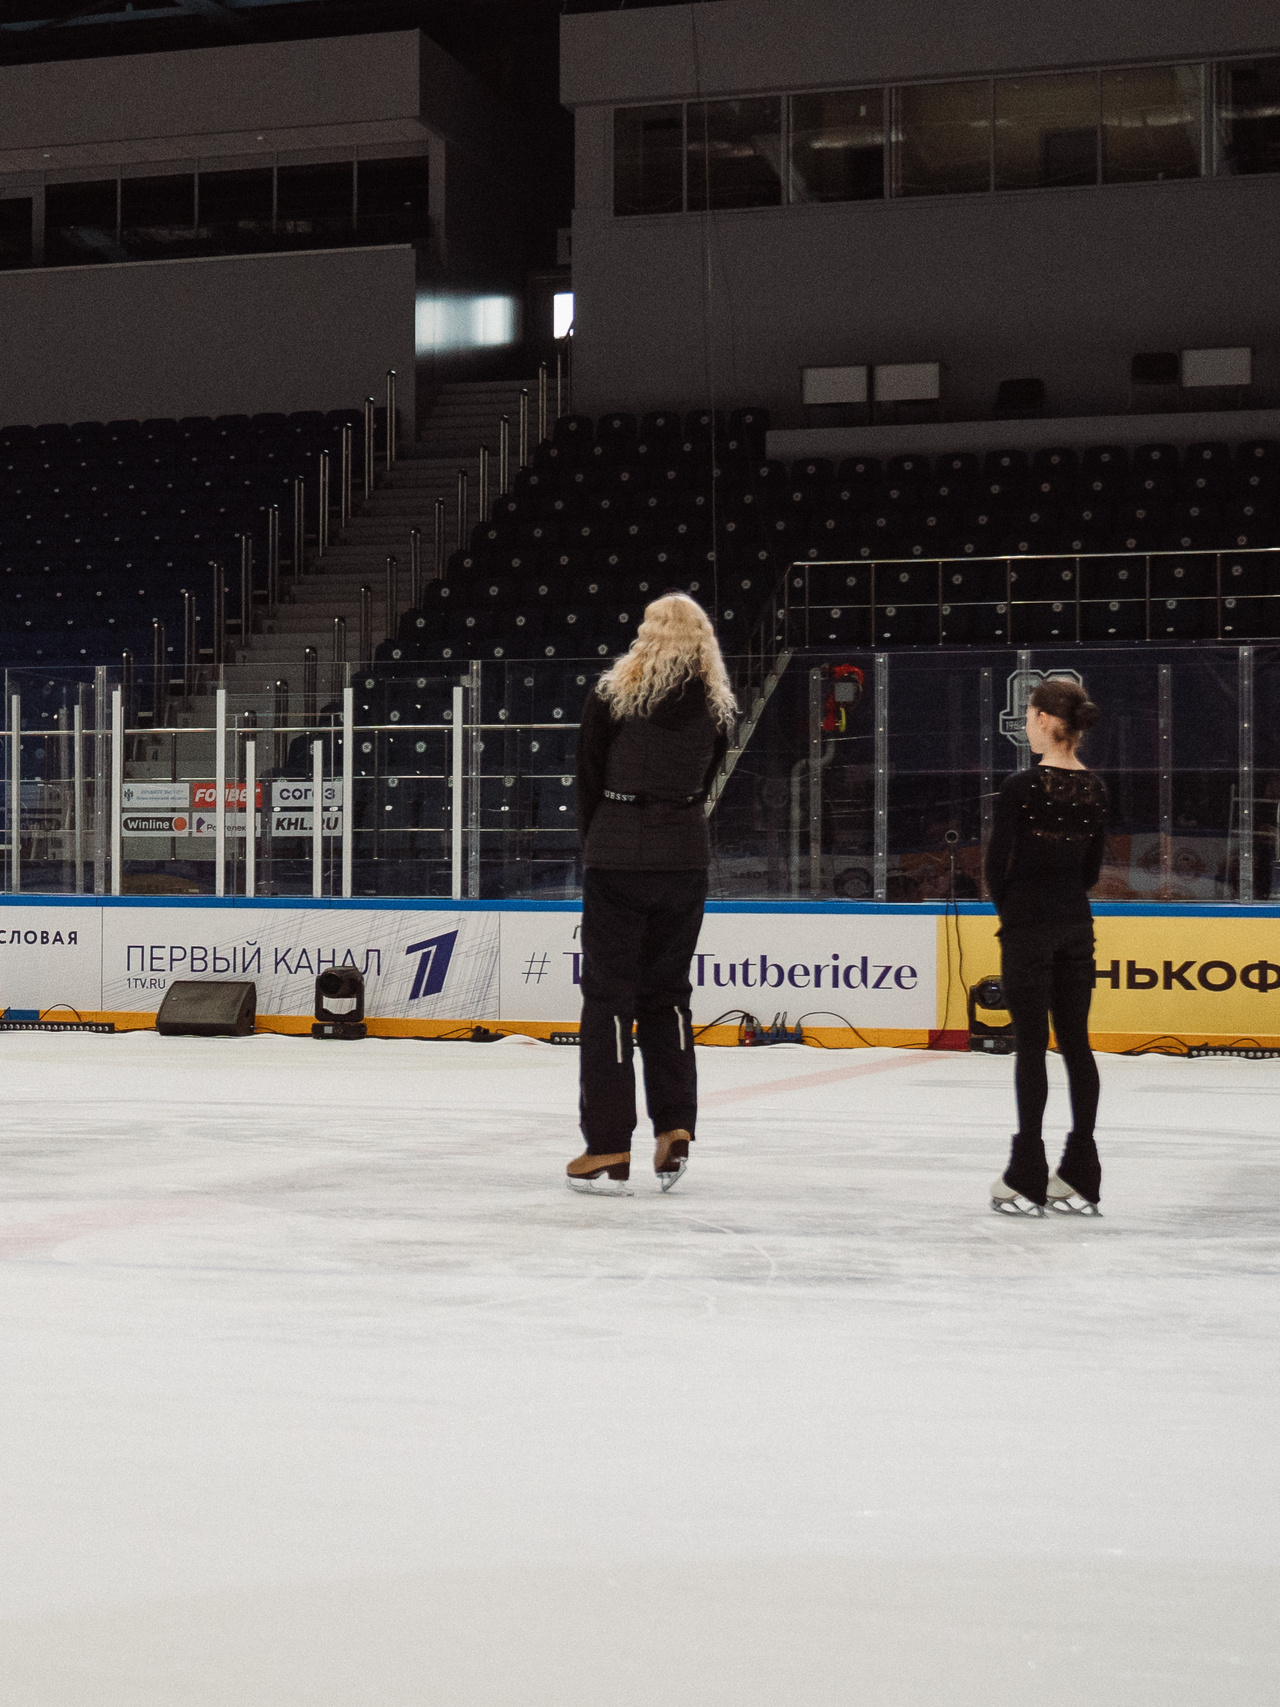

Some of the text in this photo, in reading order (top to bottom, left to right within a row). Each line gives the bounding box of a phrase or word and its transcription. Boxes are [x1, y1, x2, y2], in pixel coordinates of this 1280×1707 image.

[195, 788, 261, 802] FOBE
[279, 788, 336, 800] СОГЗ
[127, 818, 170, 830] Winline
[207, 823, 257, 832] Роелек
[126, 940, 381, 977] ПЕРВЫЙ КАНАЛ
[693, 952, 919, 990] Tutberidze
[1091, 959, 1280, 993] НЬКОФ
[126, 977, 166, 989] 1TV.RU
